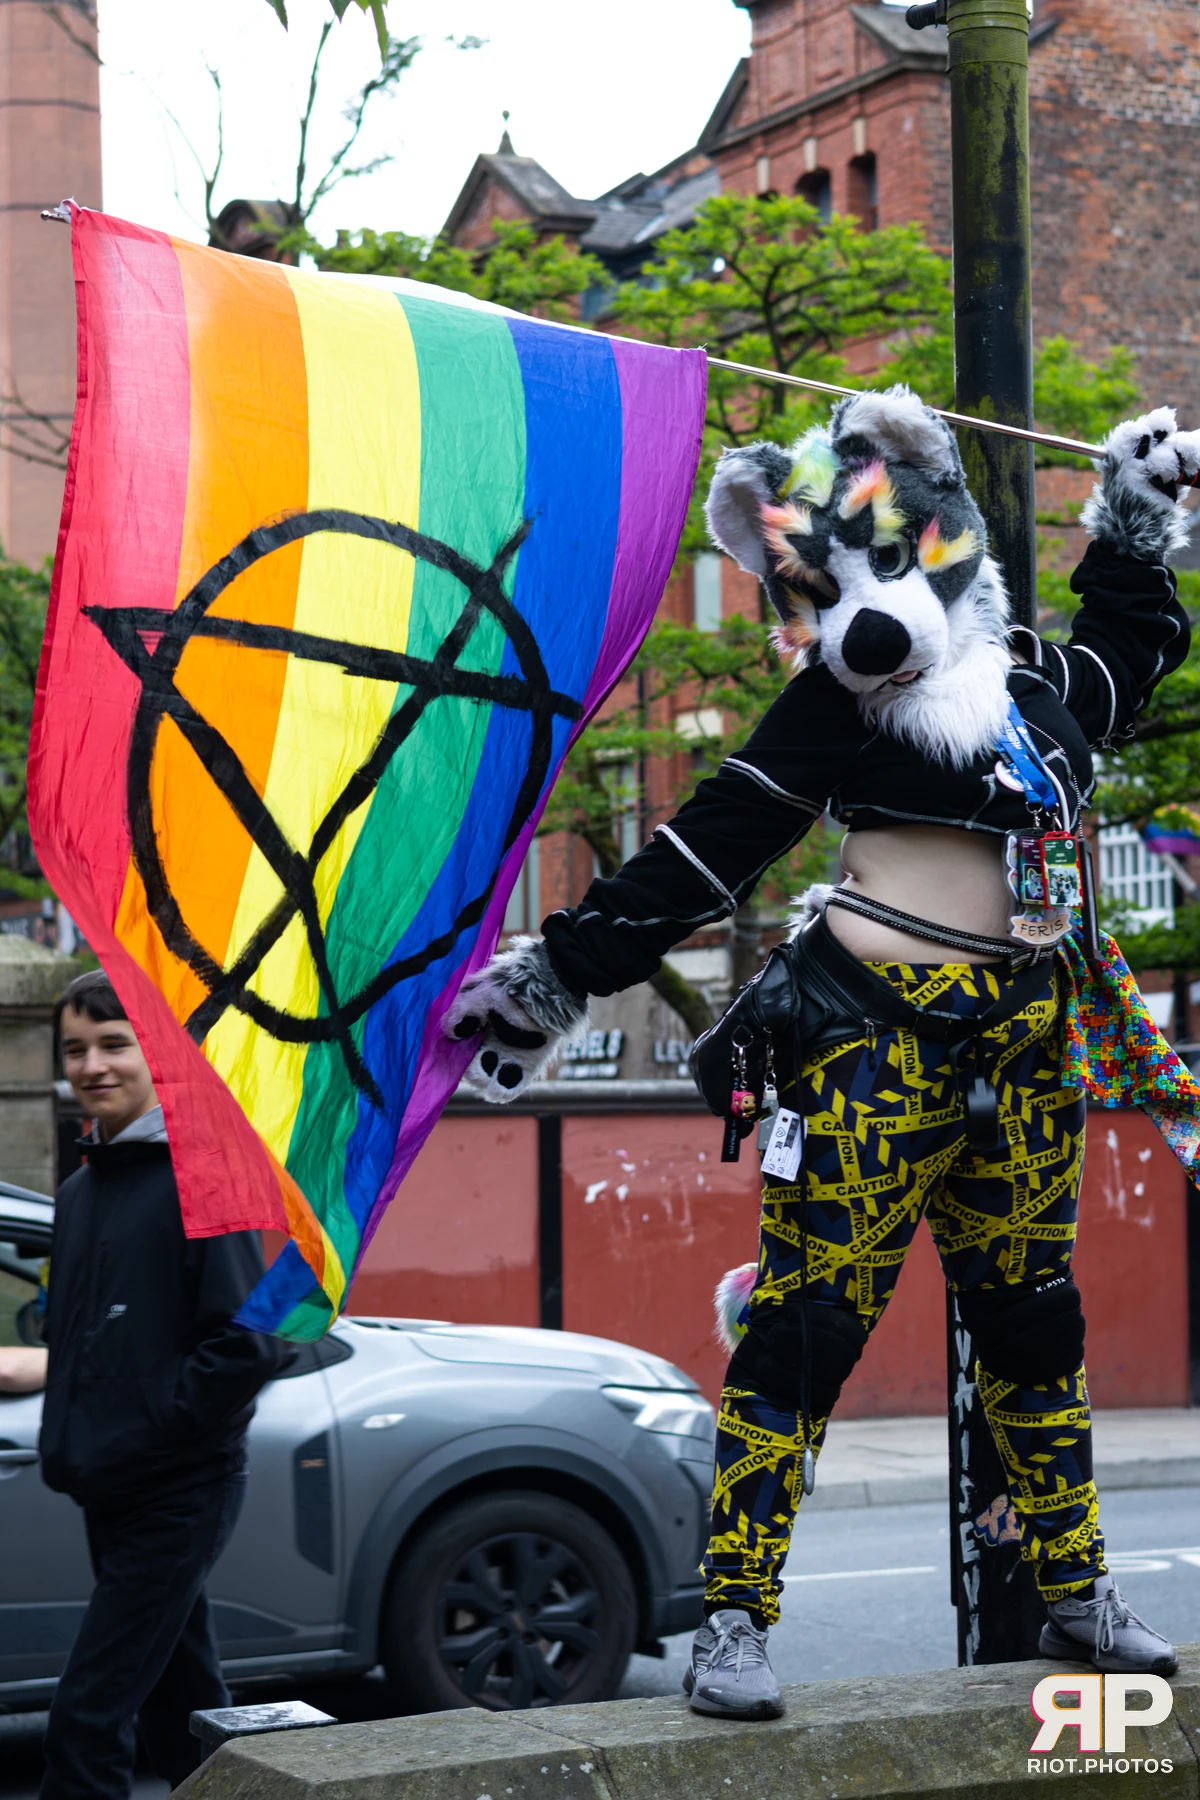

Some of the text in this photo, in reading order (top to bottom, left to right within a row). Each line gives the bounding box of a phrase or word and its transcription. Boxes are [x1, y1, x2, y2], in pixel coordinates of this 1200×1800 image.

[1020, 920, 1064, 936] FERIS
[911, 973, 952, 1005] UTION
[655, 1041, 696, 1062] LEV
[901, 1030, 916, 1075] AUTION
[1000, 1020, 1048, 1064] AUTION
[1008, 1120, 1022, 1145] TION
[840, 1136, 855, 1165] TION
[1001, 1150, 1062, 1173] CAUTIO
[836, 1176, 899, 1196] CAUTIO
[947, 1203, 987, 1225] TION
[1007, 1178, 1068, 1225] CAUTION
[774, 1224, 828, 1254] CAUTON
[849, 1205, 906, 1254] CAUTION
[950, 1231, 987, 1249] TION
[1008, 1237, 1024, 1275] AUTION
[859, 1267, 870, 1305] AUTION
[985, 1381, 1012, 1404] AUTIO
[720, 1416, 773, 1444] CAUTION
[990, 1410, 1043, 1423] AUTION
[992, 1419, 1015, 1461] AUTION
[720, 1450, 775, 1487] CAUTION
[1034, 1486, 1090, 1510] CAUTION
[1066, 1521, 1094, 1556] UTION
[1043, 1587, 1072, 1599] TION
